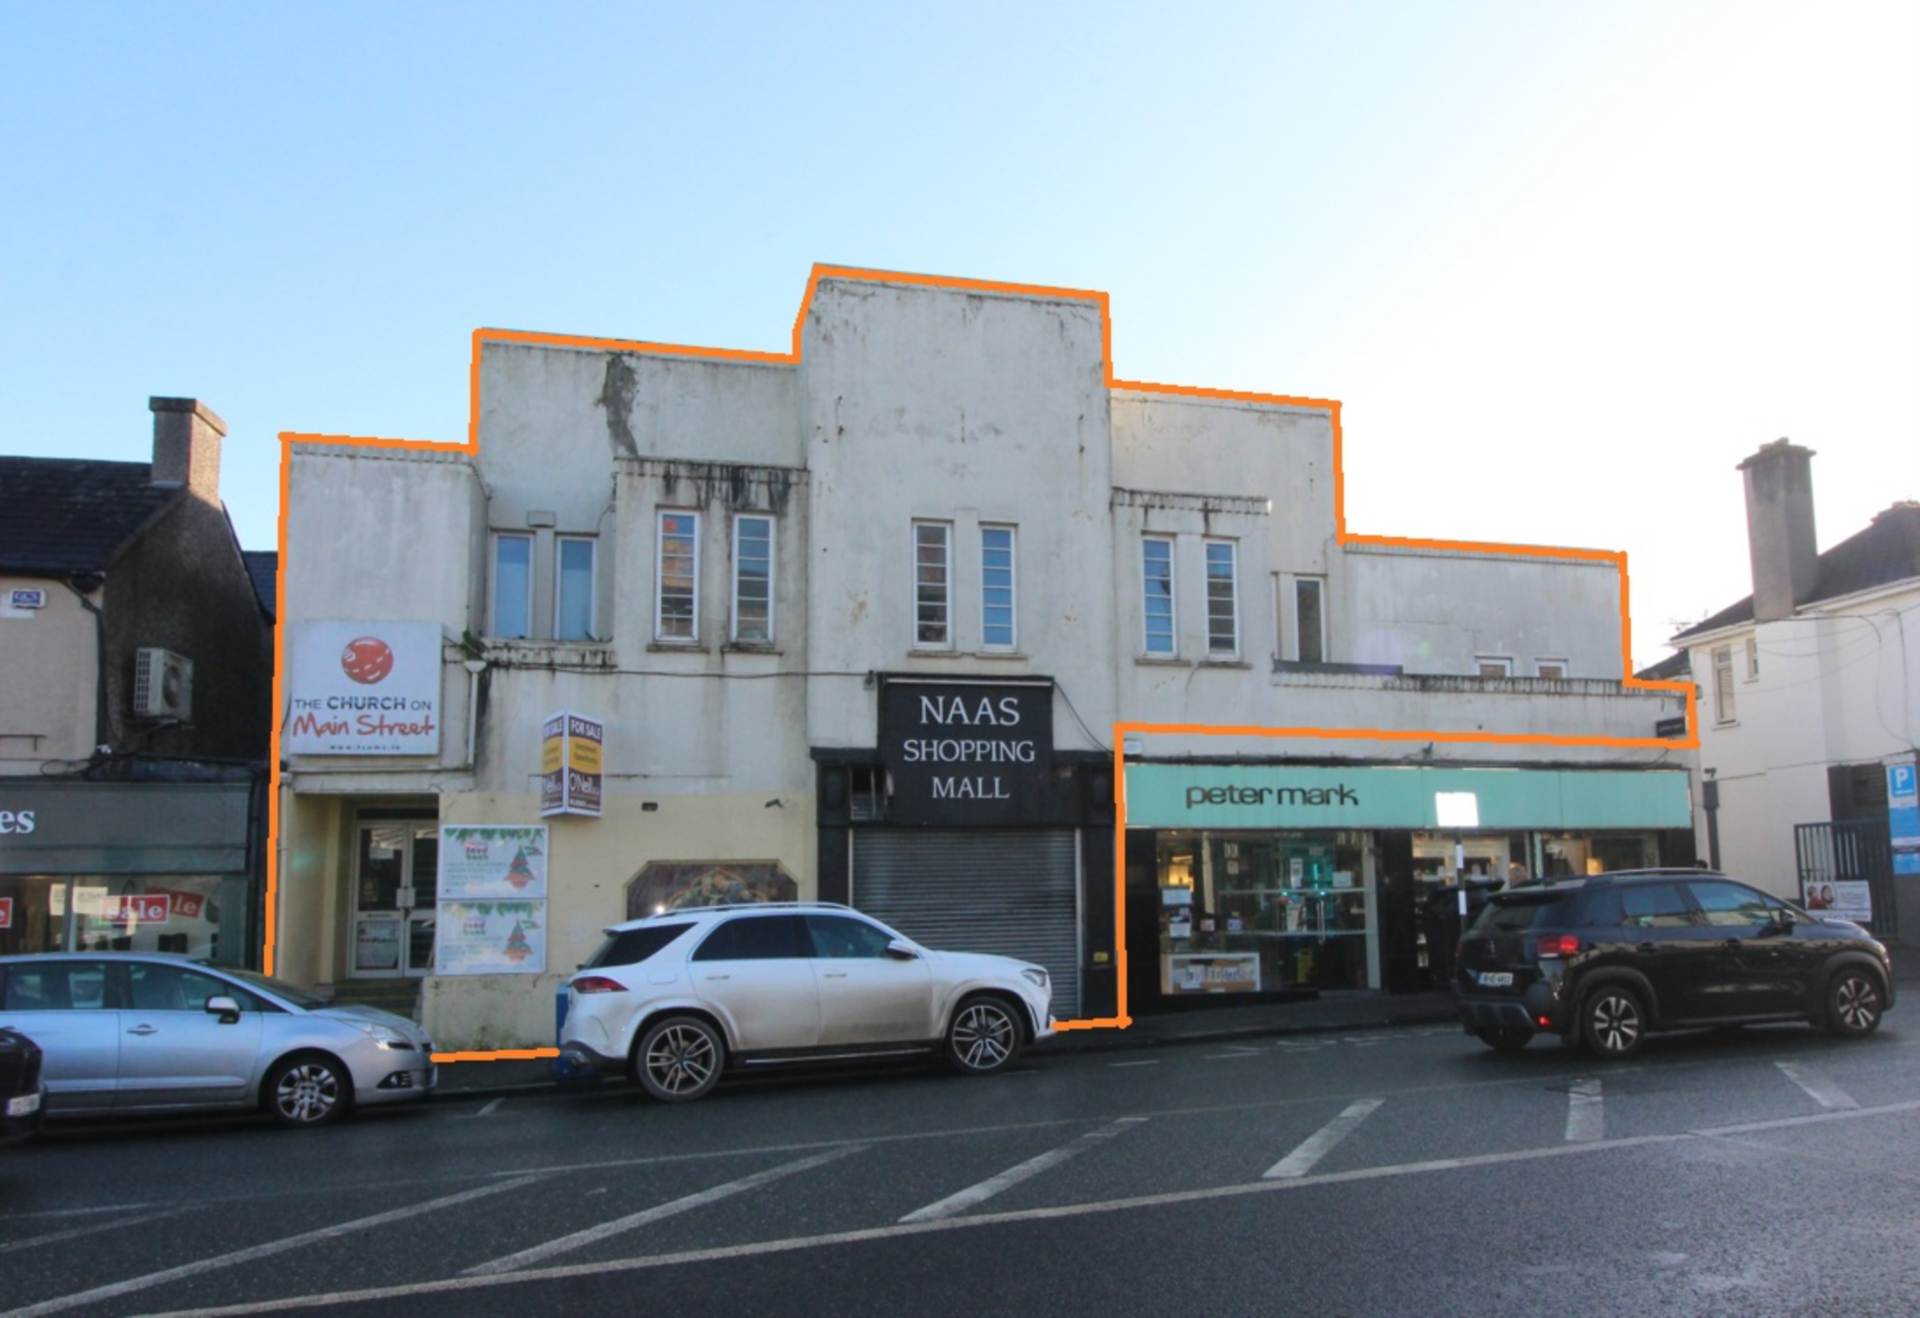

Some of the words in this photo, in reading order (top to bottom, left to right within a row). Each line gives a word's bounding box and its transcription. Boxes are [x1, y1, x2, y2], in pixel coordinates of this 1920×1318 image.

[294, 699, 322, 710] THE
[327, 696, 406, 711] CHURCH
[410, 699, 432, 711] ON
[920, 695, 1020, 727] NAAS
[292, 712, 350, 739] Main
[356, 714, 435, 737] Street
[585, 723, 601, 739] SALE
[903, 739, 1036, 762] SHOPPING
[931, 776, 1011, 799] MALL
[1895, 767, 1909, 788] P
[1186, 784, 1273, 809] peter
[1277, 783, 1359, 806] mark
[0, 809, 35, 834] es
